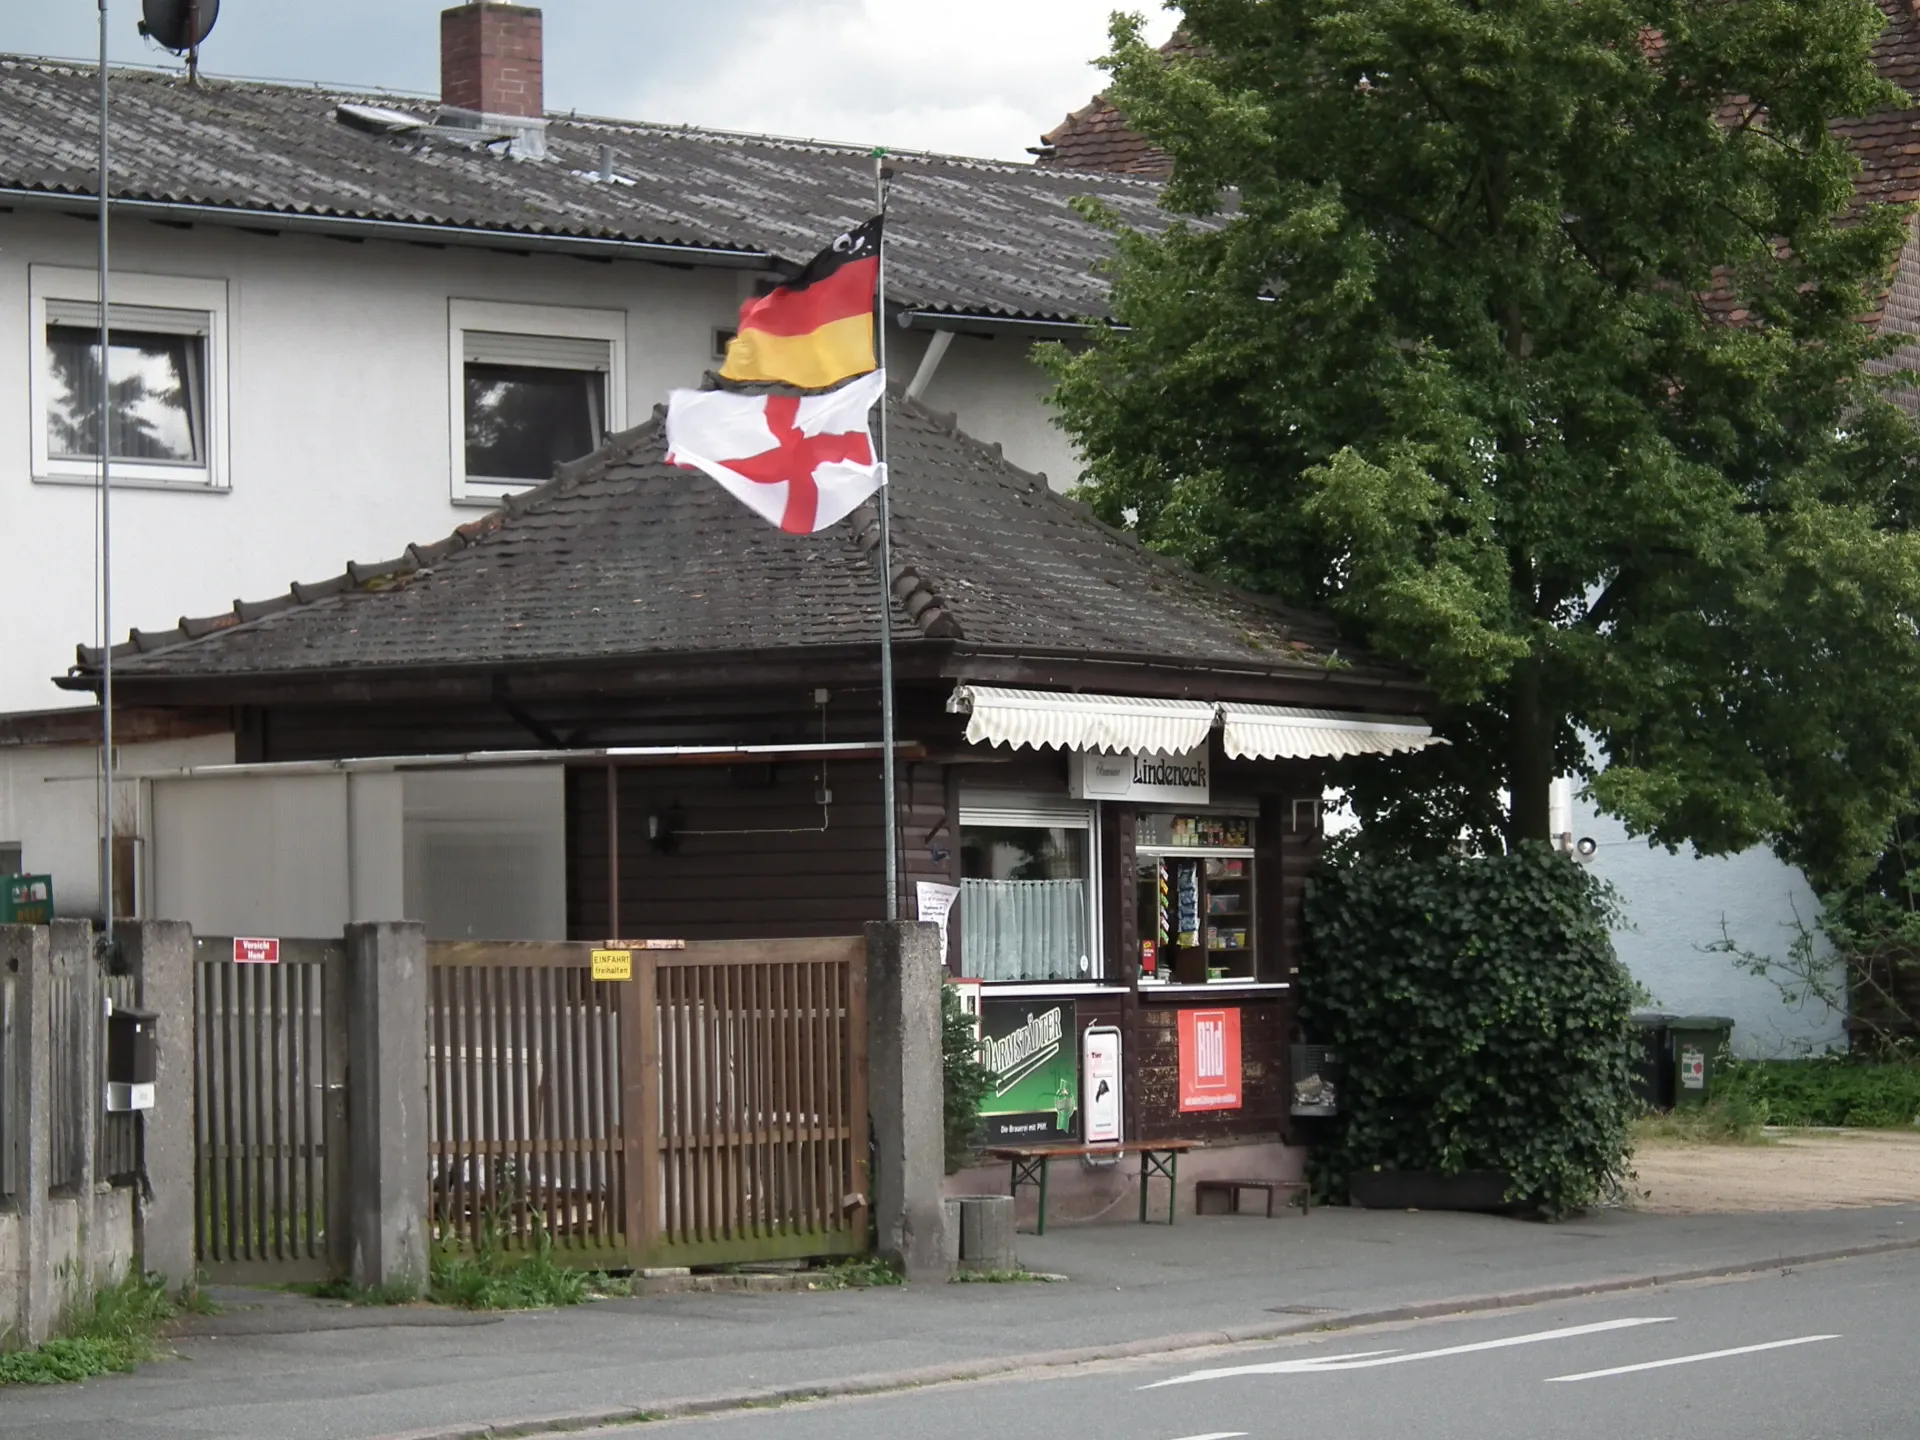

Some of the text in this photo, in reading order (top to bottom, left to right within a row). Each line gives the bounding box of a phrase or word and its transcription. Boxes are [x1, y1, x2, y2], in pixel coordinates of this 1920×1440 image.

[1132, 756, 1207, 788] Lindeneck
[243, 940, 270, 950] Vorsicht
[247, 950, 265, 960] Hund
[593, 955, 629, 964] EINFAHRT
[595, 966, 628, 974] freihalten
[981, 1006, 1063, 1074] DARMSTÄDTER
